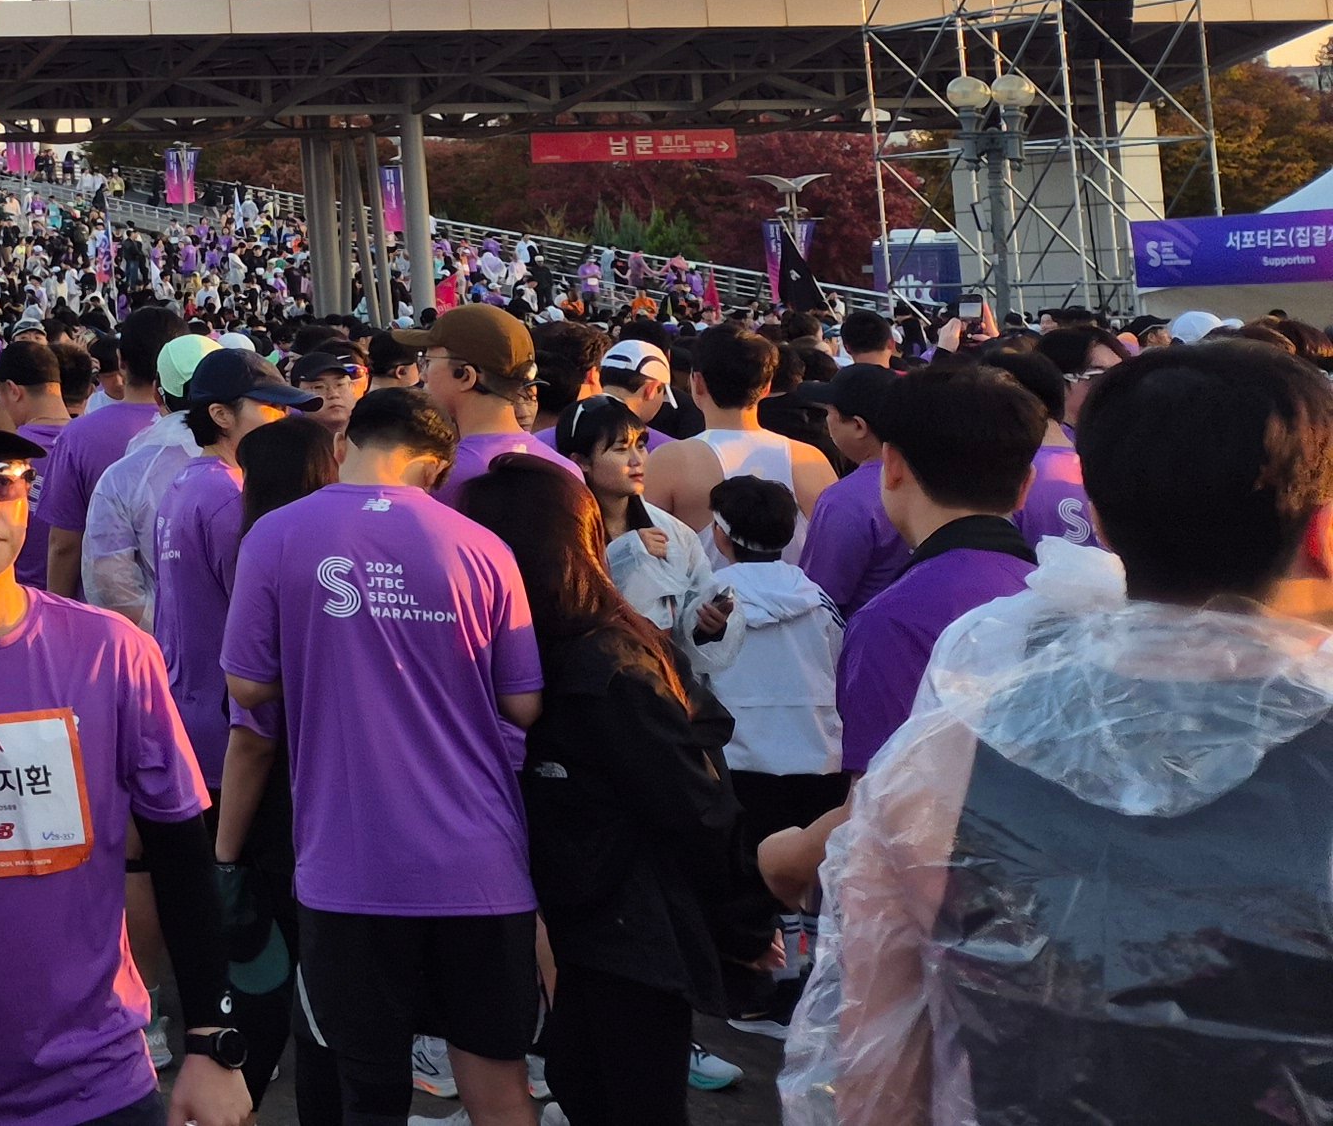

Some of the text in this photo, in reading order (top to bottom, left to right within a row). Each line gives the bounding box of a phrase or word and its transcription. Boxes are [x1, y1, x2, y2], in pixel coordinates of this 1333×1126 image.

[1262, 255, 1316, 267] Supporters
[365, 562, 404, 576] 2024
[317, 556, 362, 618] S
[366, 577, 405, 590] JTBC
[368, 591, 419, 606] SEOUL
[370, 606, 457, 623] MARATHON
